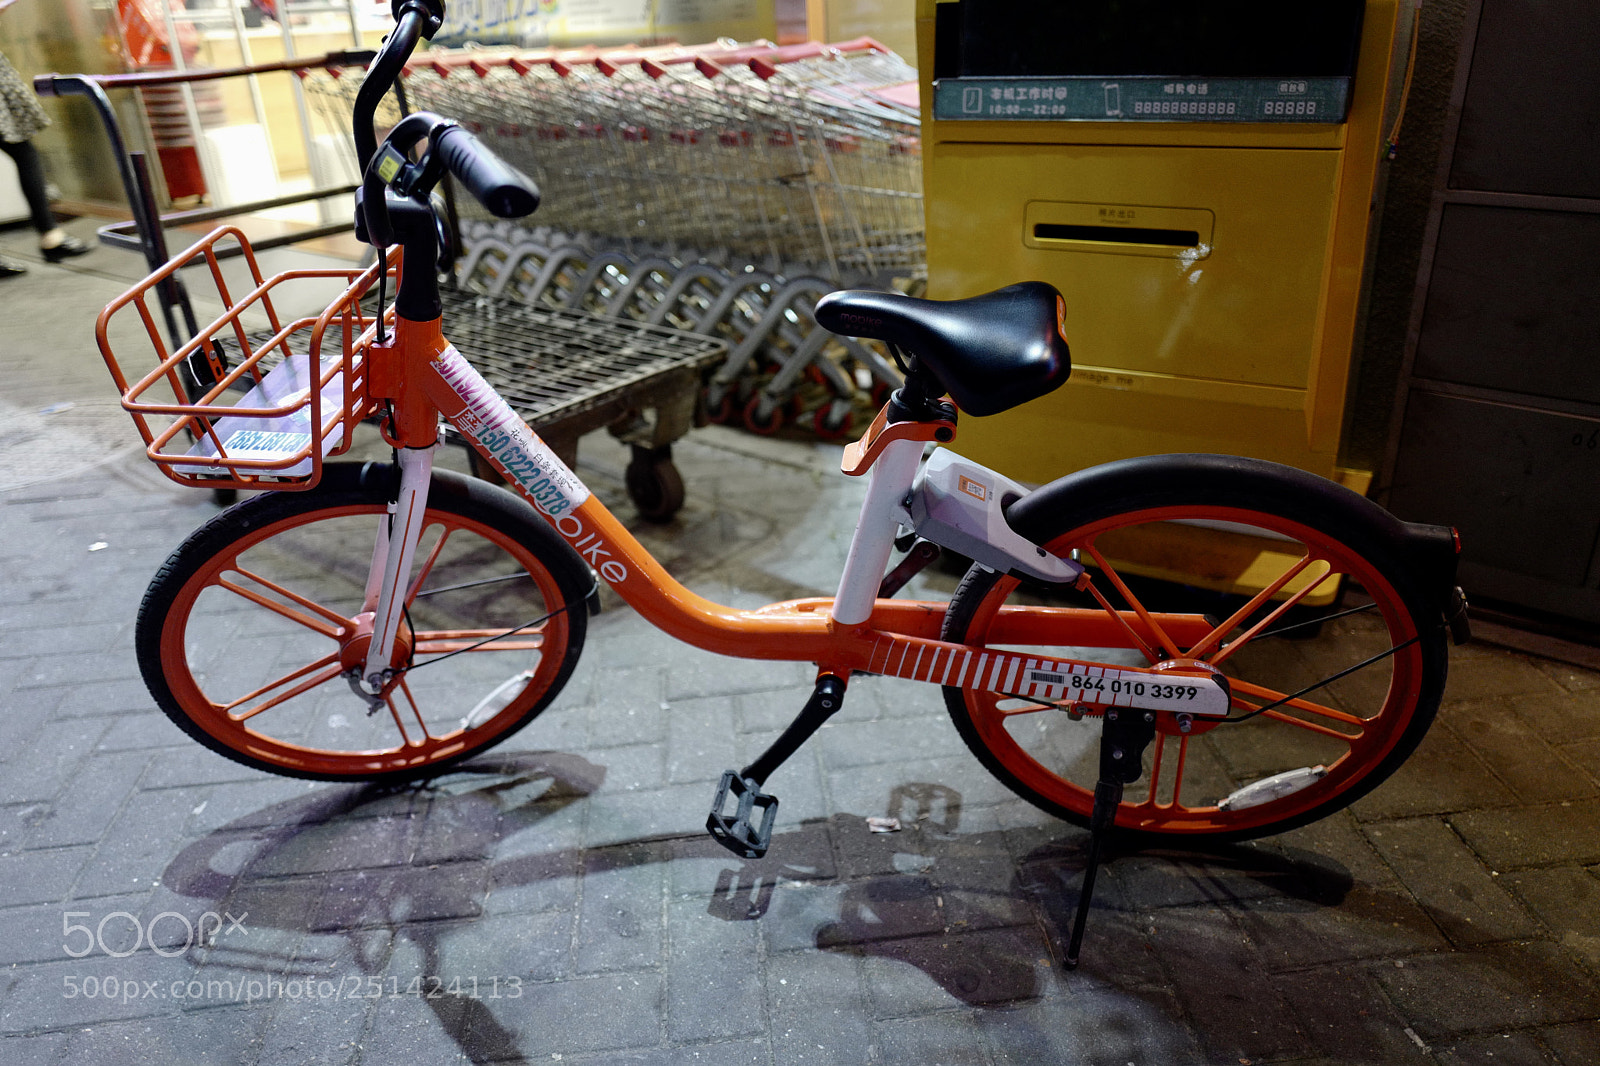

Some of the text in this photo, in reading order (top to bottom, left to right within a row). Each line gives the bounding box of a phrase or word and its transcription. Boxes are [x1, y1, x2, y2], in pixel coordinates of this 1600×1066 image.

[840, 312, 882, 327] mobike
[499, 446, 542, 486] 6222
[528, 478, 571, 516] 0378
[1071, 675, 1199, 700] 864 010 3399
